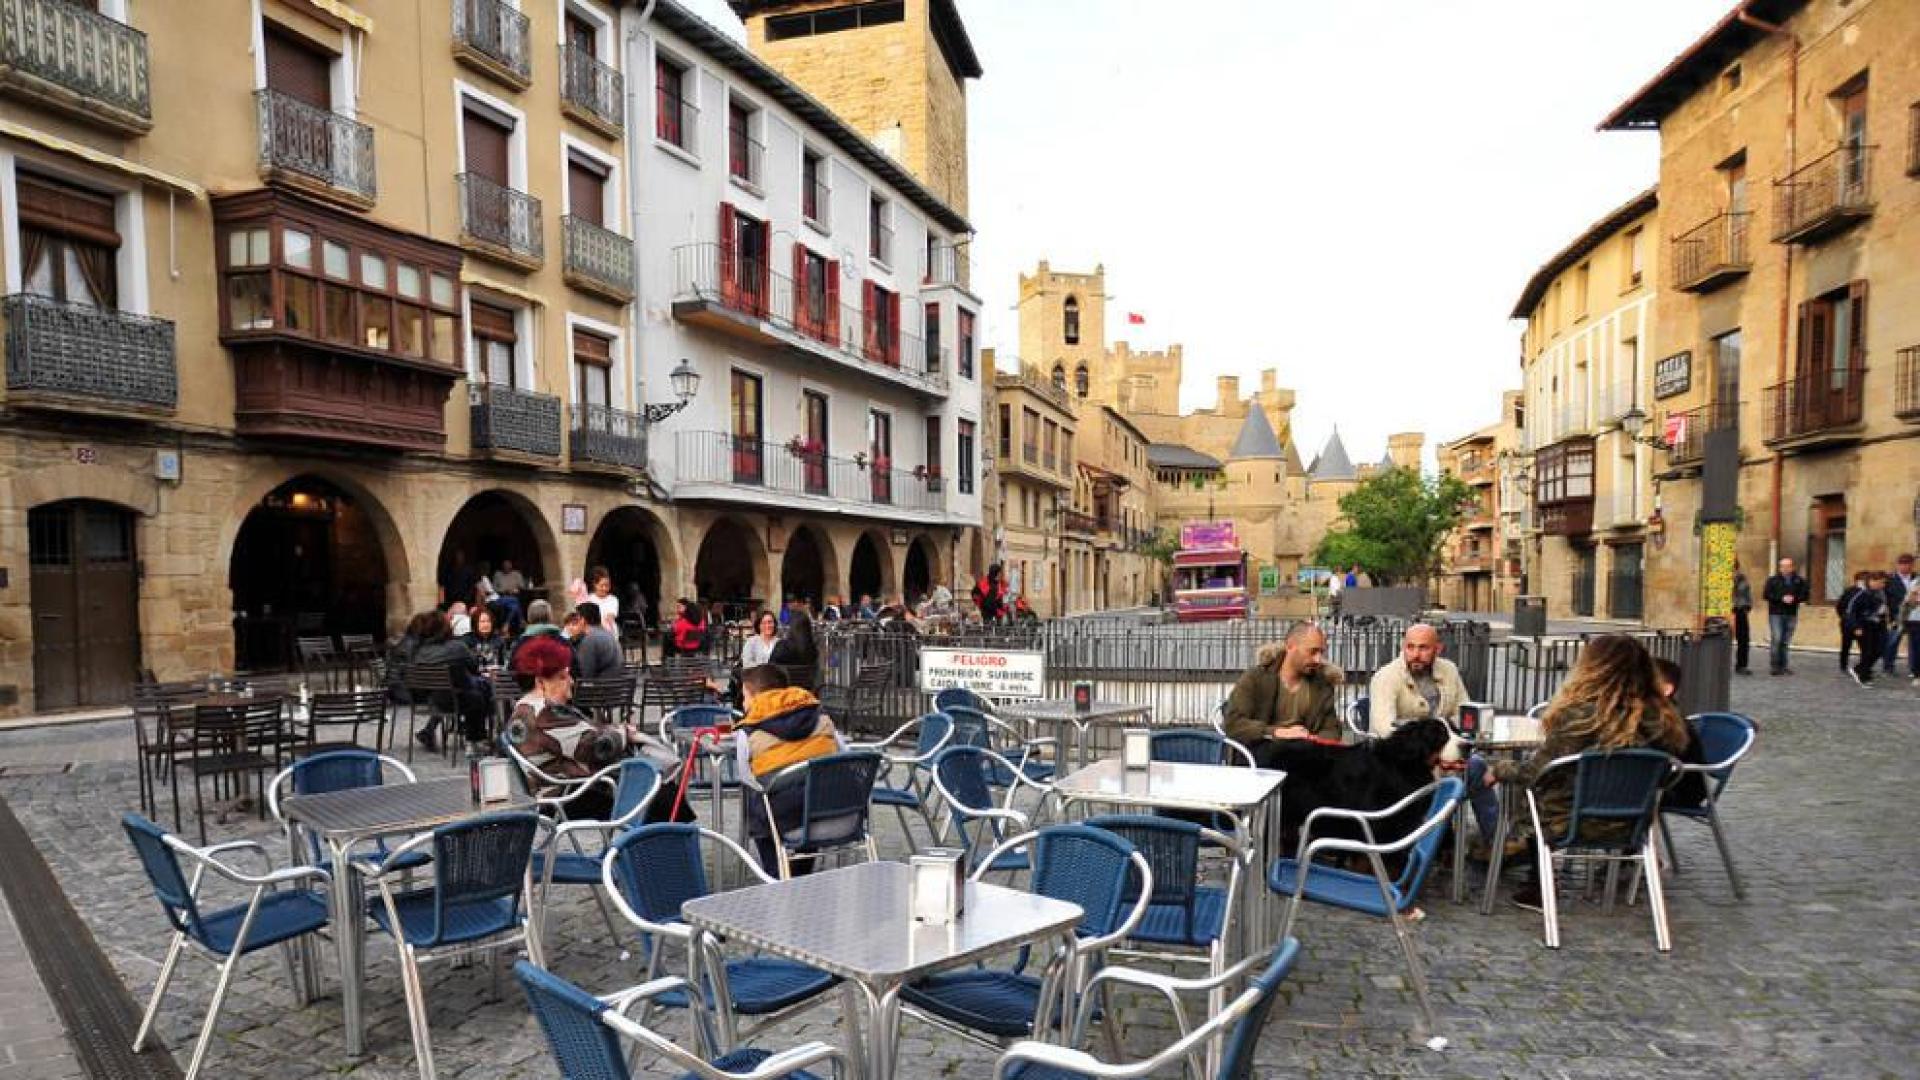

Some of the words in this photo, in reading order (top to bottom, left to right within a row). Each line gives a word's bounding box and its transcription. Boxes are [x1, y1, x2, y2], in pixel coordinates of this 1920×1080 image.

[952, 654, 1007, 667] PELIGRO
[928, 667, 982, 679] PROHIBIDO
[988, 670, 1034, 681] SUBIRSE
